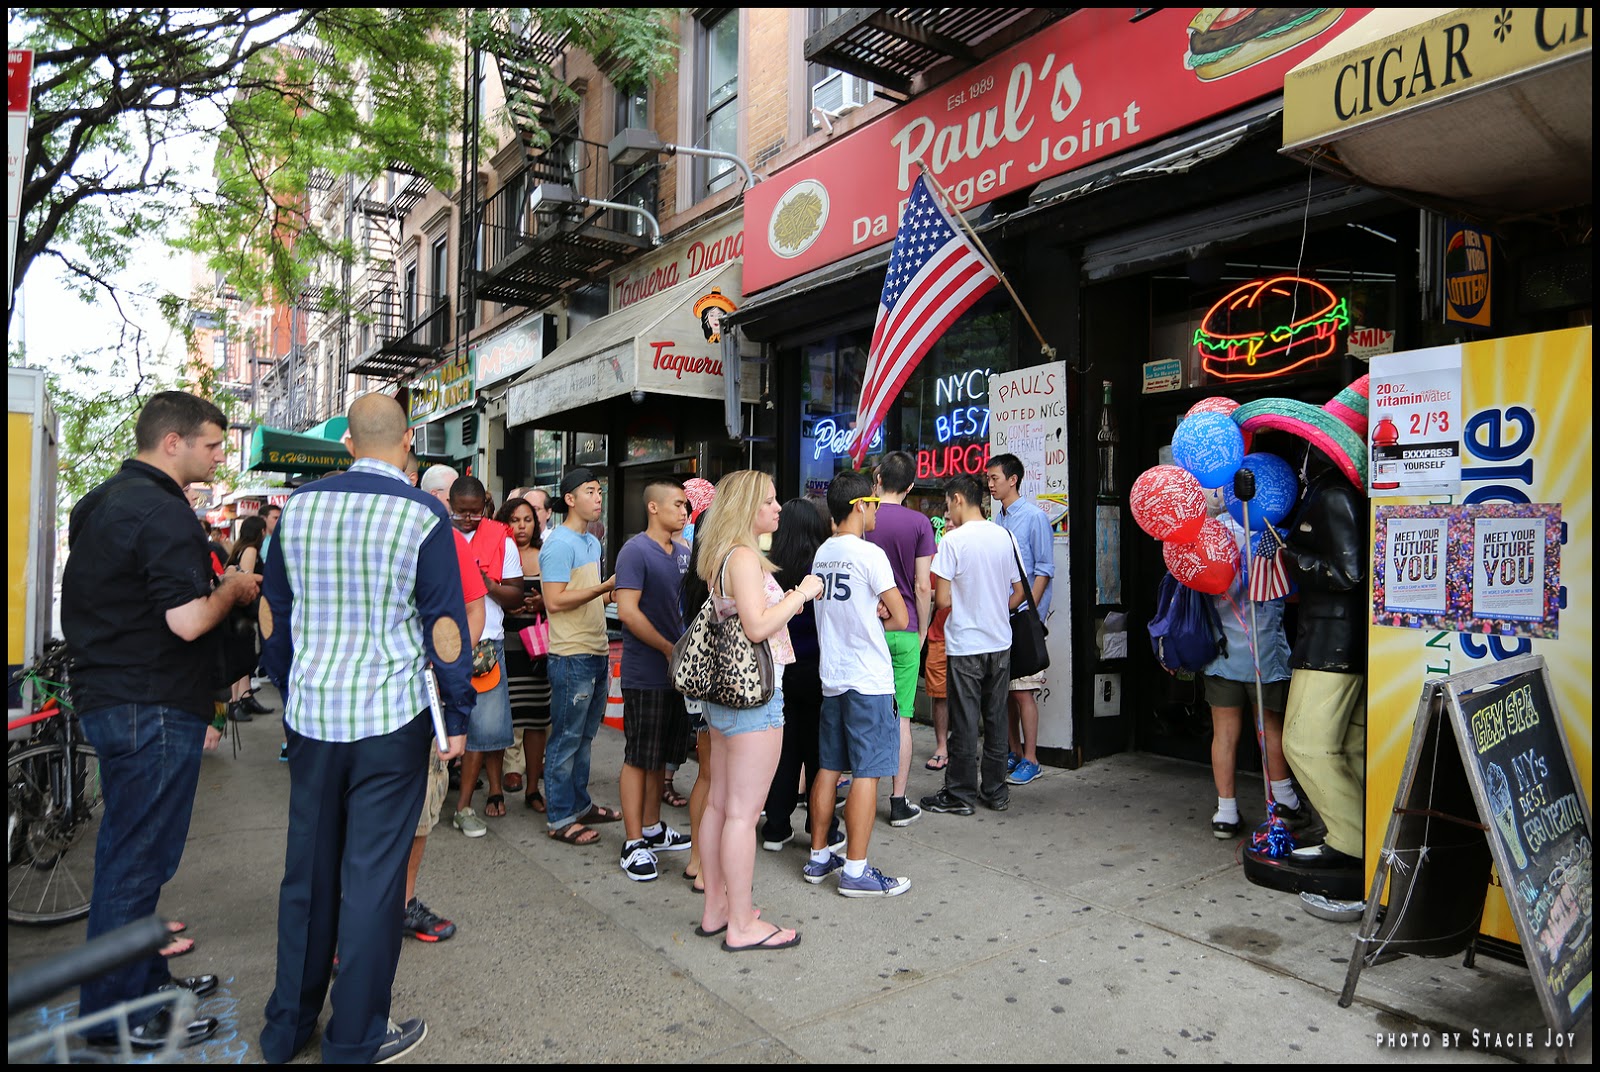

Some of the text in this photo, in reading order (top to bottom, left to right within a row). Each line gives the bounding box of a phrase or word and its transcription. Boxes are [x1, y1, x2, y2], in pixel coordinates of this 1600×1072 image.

[1334, 23, 1473, 121] CIGAR
[947, 75, 994, 112] Est. 1989
[890, 53, 1082, 192] Paul's
[852, 215, 888, 245] Da
[1028, 100, 1140, 173] Joint
[1464, 229, 1481, 249] NEW
[1466, 248, 1487, 271] YORK
[616, 261, 680, 309] Taqueria
[1446, 272, 1488, 307] LOTTERY
[998, 371, 1056, 403] PAUL'S
[996, 408, 1036, 422] VOTED
[307, 456, 335, 466] DAIRY
[1402, 448, 1453, 459] EXXXPRESS
[1404, 461, 1446, 471] YOURSELF
[240, 500, 258, 510] ATM
[1394, 528, 1440, 542] MEET YOUR
[1484, 529, 1536, 544] MEET YOUR
[1394, 539, 1438, 557] FUTURE
[1482, 540, 1535, 559] FUTURE
[842, 562, 852, 570] FC
[1393, 554, 1438, 583] YOU
[1482, 556, 1534, 586] YOU
[1472, 684, 1540, 755] GEM SPA
[1518, 783, 1547, 817] BEST
